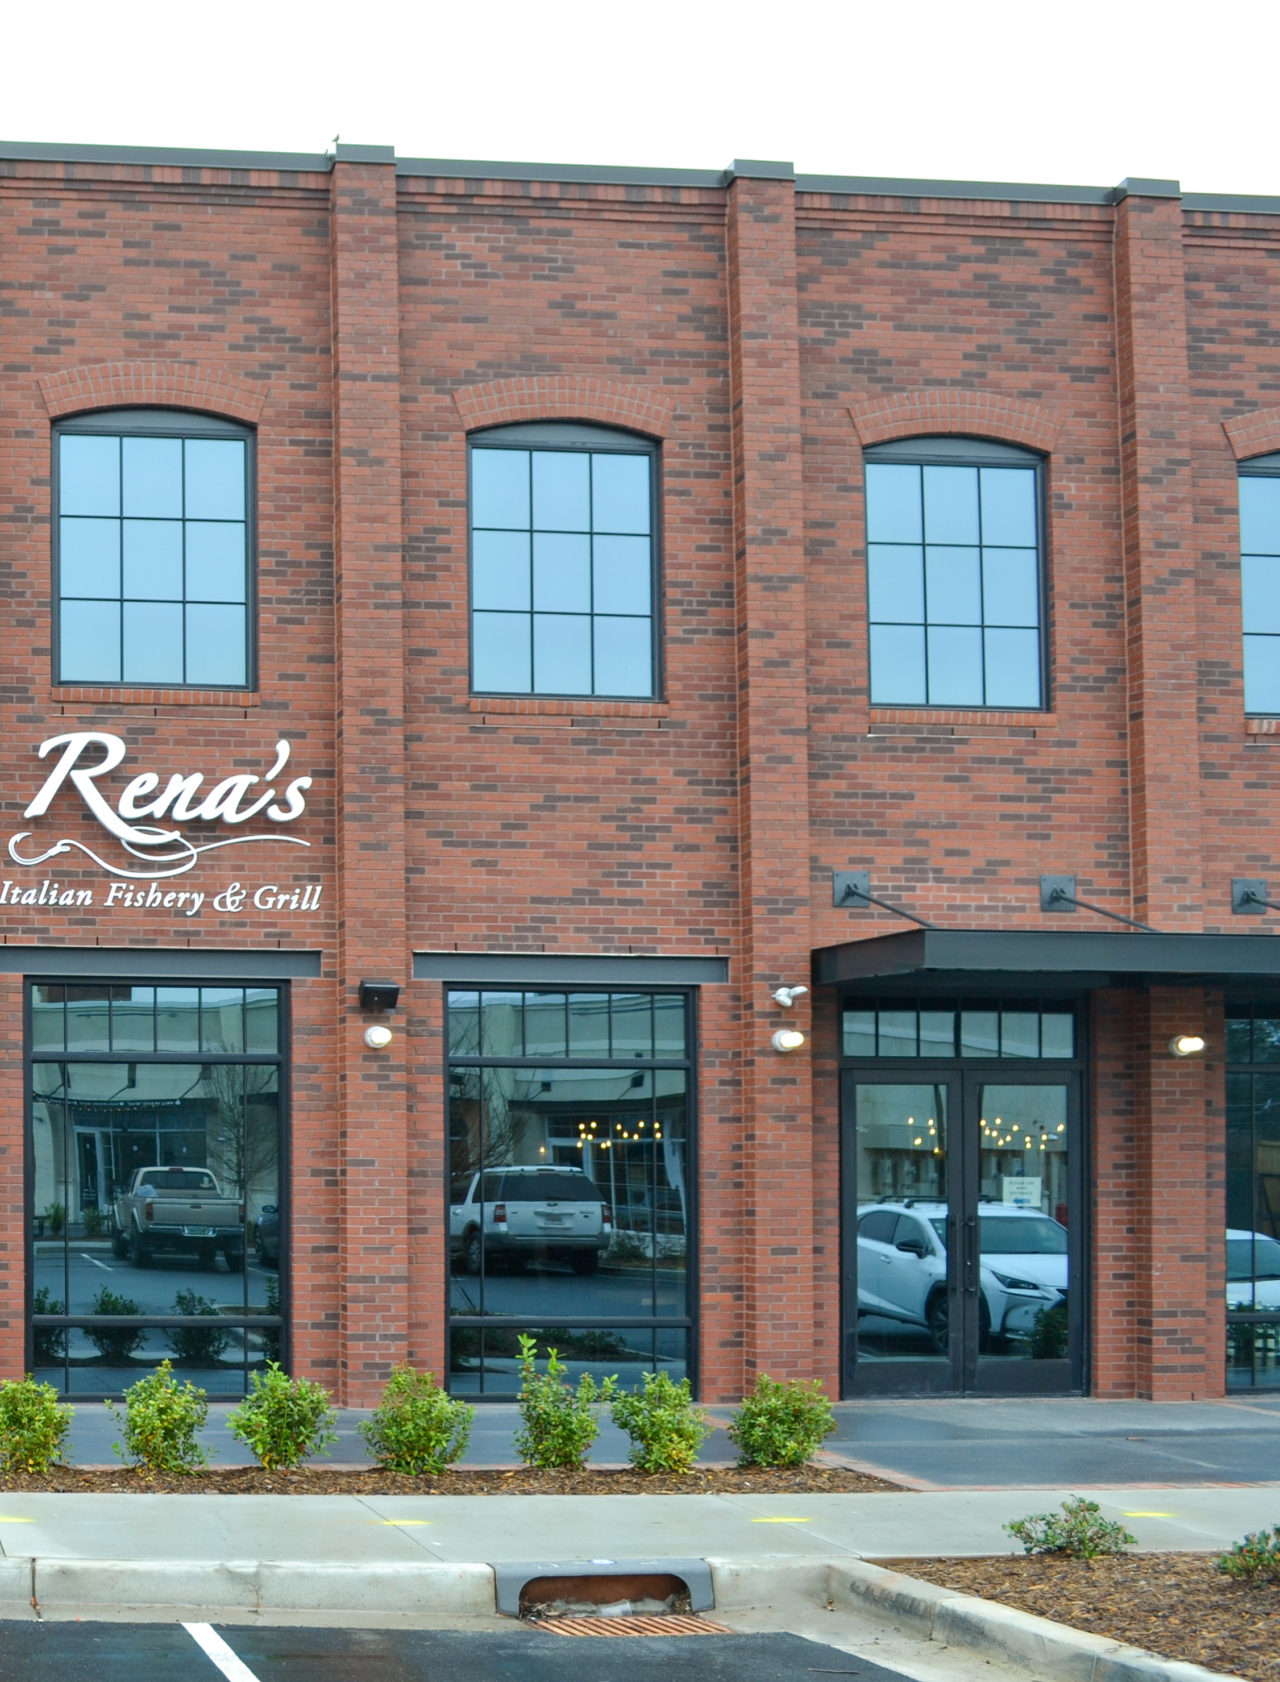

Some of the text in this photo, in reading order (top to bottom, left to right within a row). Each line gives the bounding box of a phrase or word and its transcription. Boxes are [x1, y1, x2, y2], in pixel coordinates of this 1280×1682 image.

[23, 731, 313, 844] Rena's
[104, 882, 205, 916] Fishery
[213, 882, 245, 912] &
[253, 884, 322, 911] Grill
